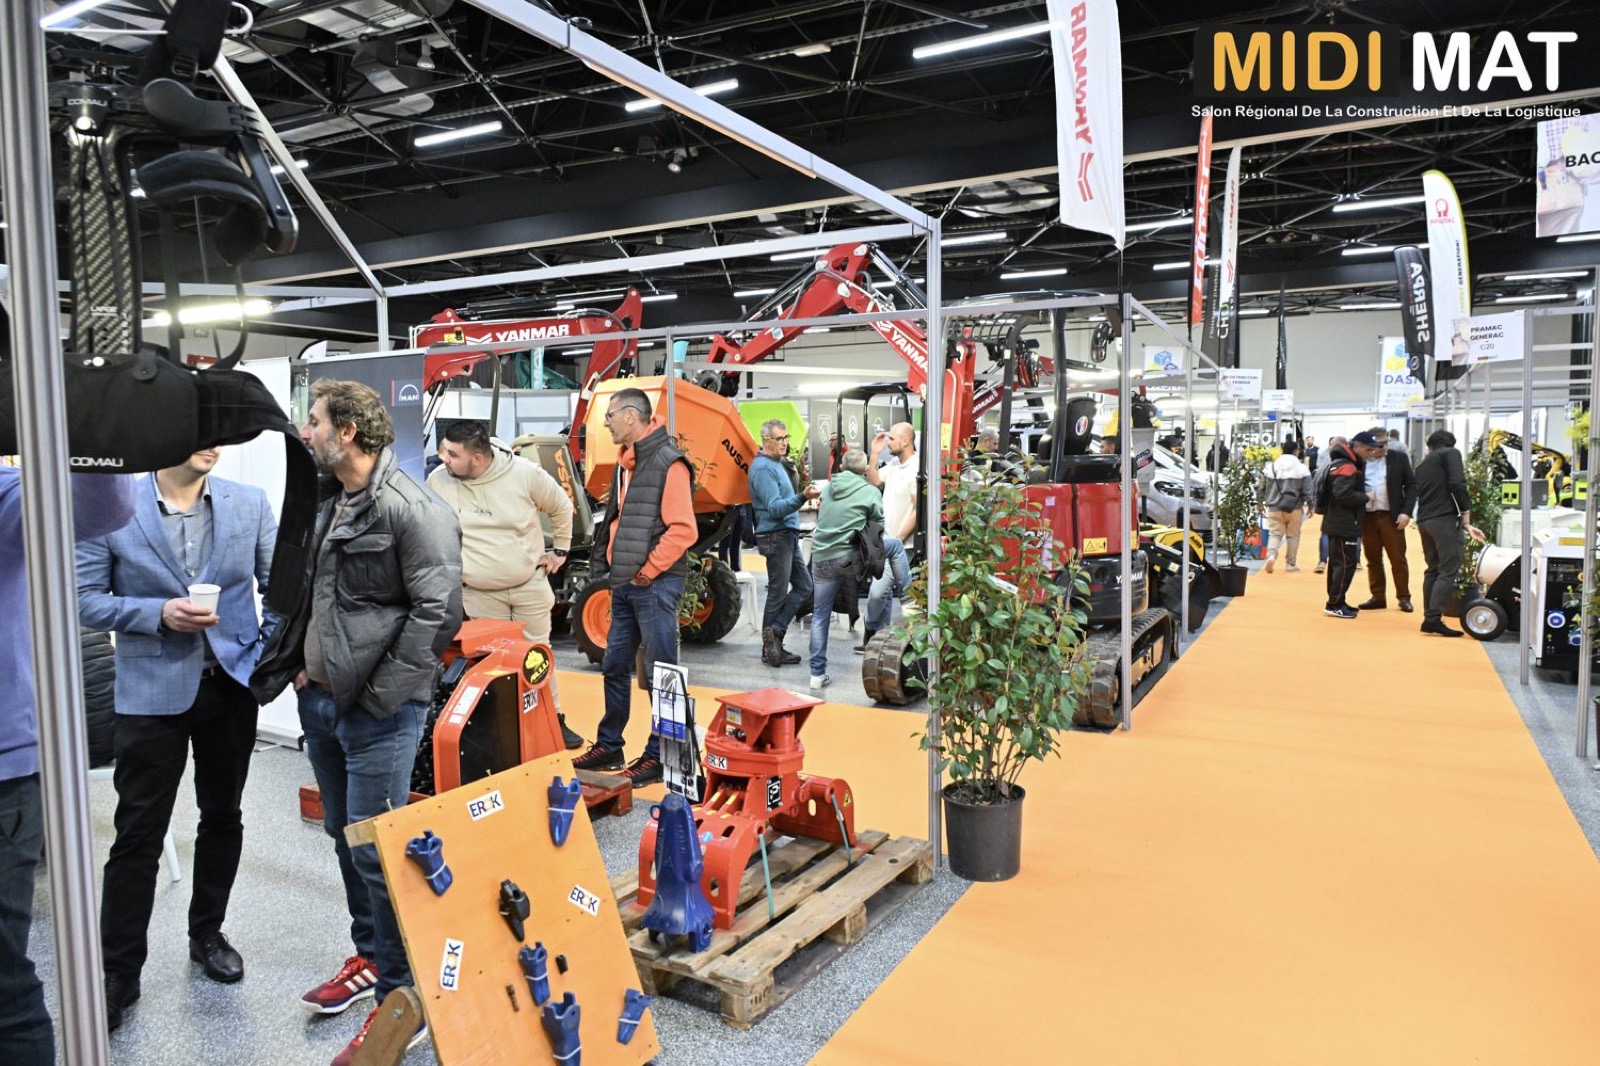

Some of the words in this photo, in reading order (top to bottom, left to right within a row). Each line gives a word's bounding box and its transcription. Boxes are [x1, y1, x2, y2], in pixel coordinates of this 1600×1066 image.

[495, 324, 570, 343] YANMAR
[1470, 324, 1503, 333] PRAMAC
[1469, 332, 1504, 341] GENERAC
[70, 456, 124, 467] COMAU
[721, 438, 748, 475] AUSA
[554, 448, 577, 514] USA
